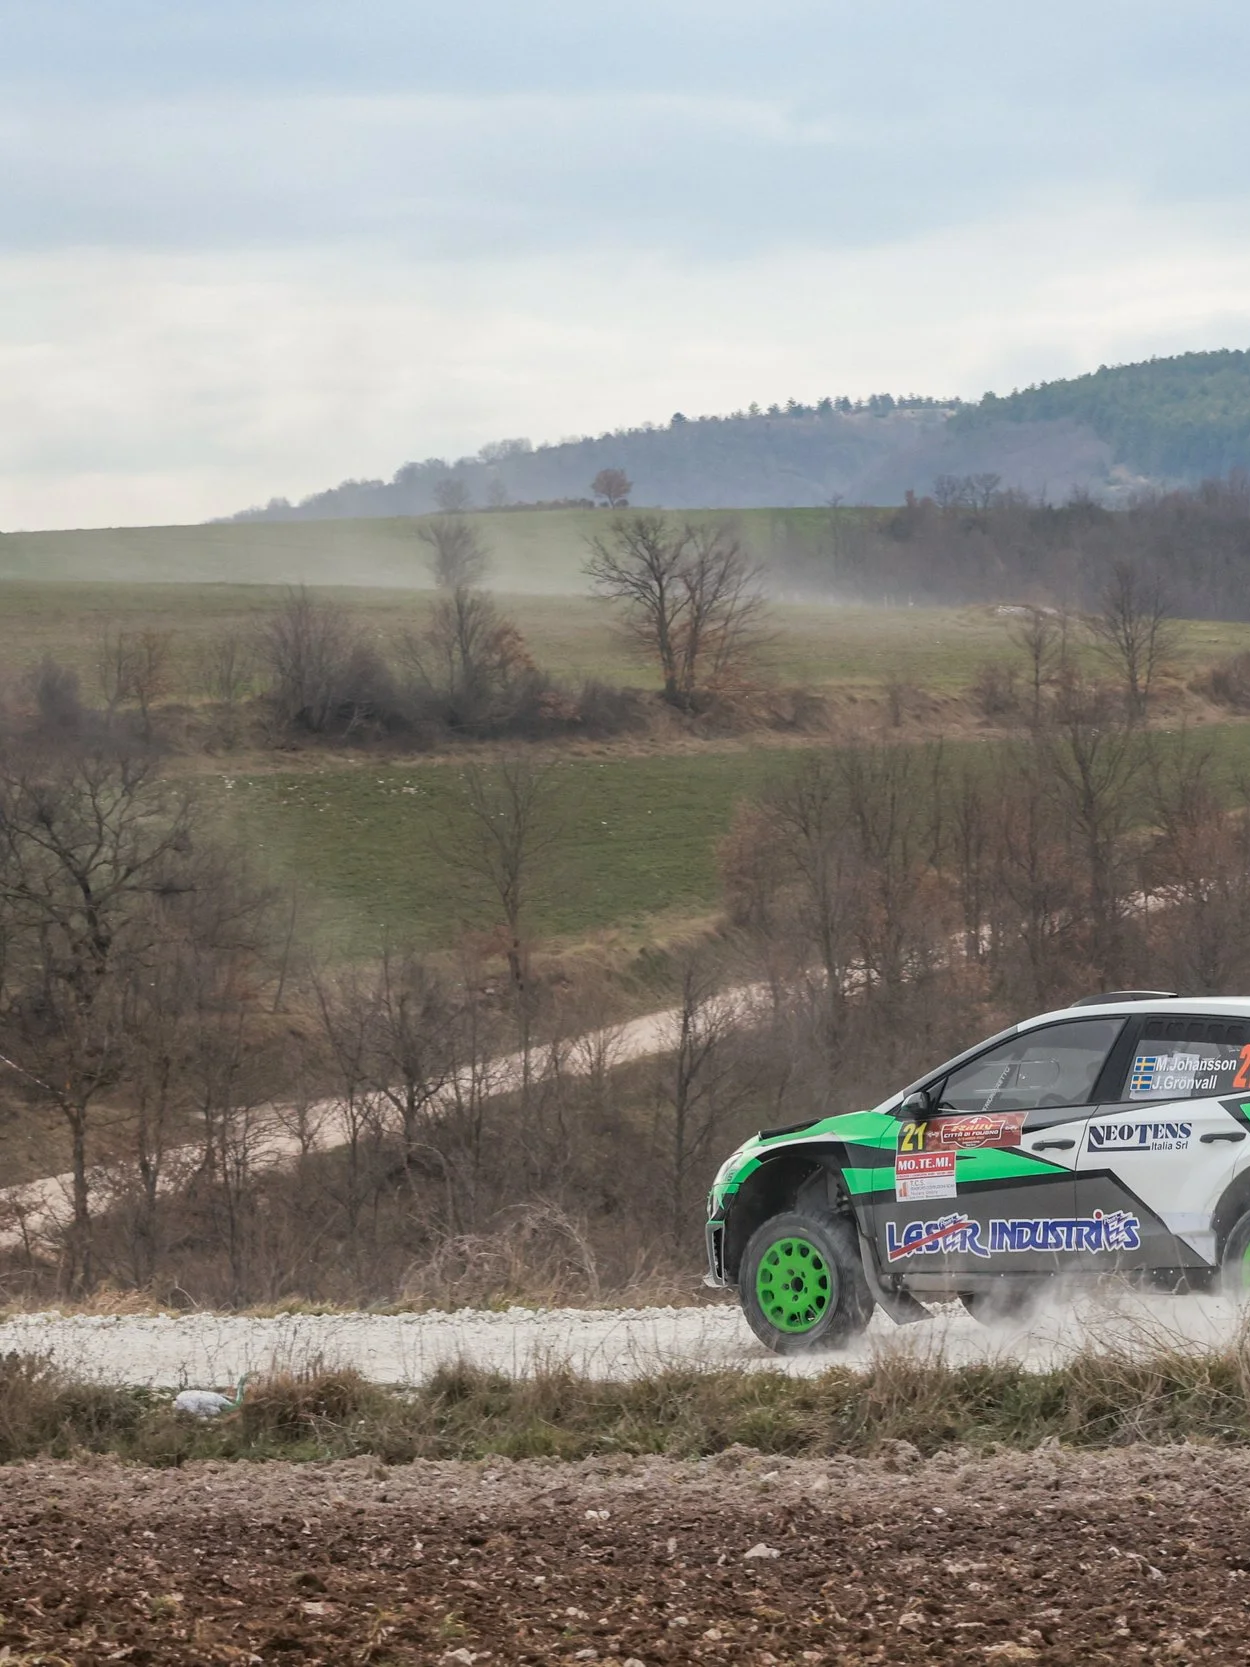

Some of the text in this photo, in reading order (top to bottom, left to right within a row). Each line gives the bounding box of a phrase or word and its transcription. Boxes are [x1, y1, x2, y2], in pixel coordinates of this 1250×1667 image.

[1155, 1058, 1237, 1071] M.Johansson
[1152, 1075, 1217, 1090] J.Grönvall
[951, 1123, 993, 1133] Rally
[901, 1122, 928, 1151] 21
[1087, 1123, 1193, 1148] NEOTENS
[1151, 1141, 1188, 1151] Italia Srl
[898, 1157, 952, 1171] MO.TE.MI.
[887, 1210, 1140, 1262] LASER INDUSTRIES
